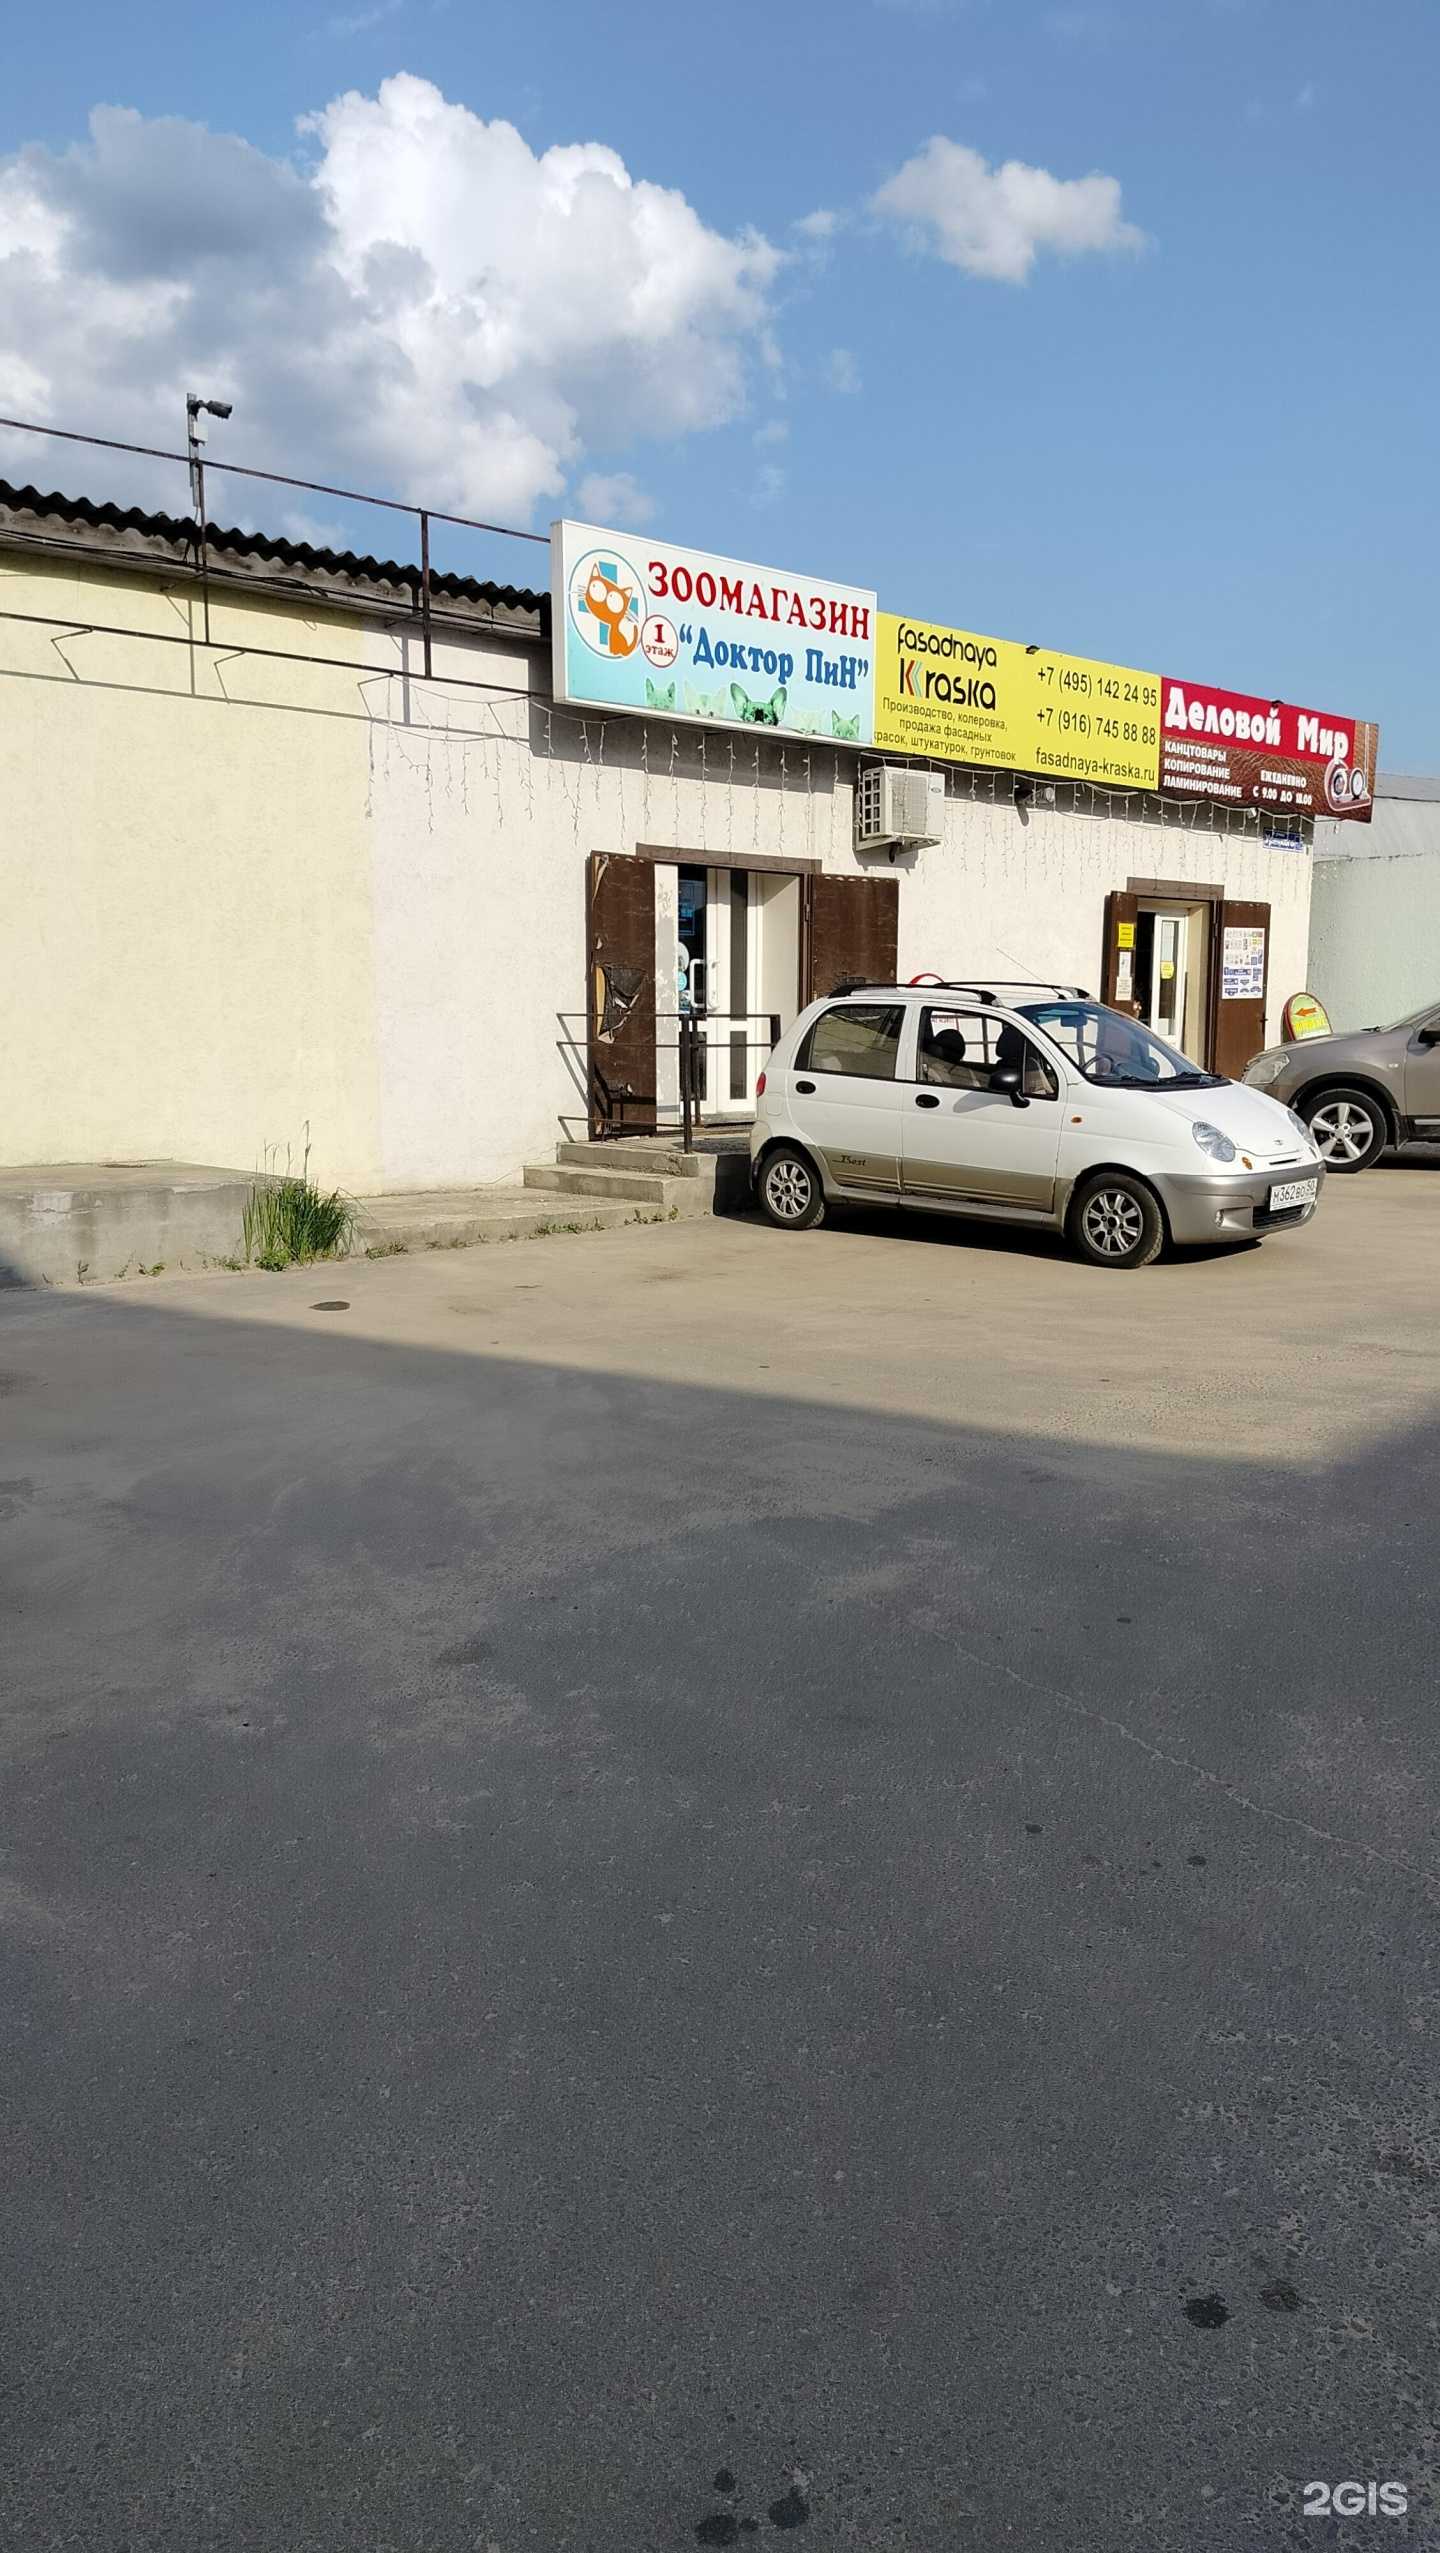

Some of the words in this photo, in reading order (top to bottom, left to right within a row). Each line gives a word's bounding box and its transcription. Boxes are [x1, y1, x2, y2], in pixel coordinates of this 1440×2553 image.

[648, 561, 870, 640] ЗООМАГАЗИН
[654, 624, 666, 643] 1
[645, 644, 675, 658] этаж
[897, 623, 997, 671] fasadnaya
[1037, 666, 1055, 686] +7
[1059, 669, 1092, 699] (495)
[1097, 677, 1120, 699] 142
[1123, 683, 1139, 703] 24
[1142, 687, 1157, 707] 95
[882, 696, 956, 721] Производство,
[957, 713, 1008, 732] колеровка,
[1036, 707, 1054, 727] +7
[1058, 709, 1092, 739] (916)
[1096, 717, 1119, 739] 745
[1123, 722, 1138, 742] 88
[1141, 726, 1156, 745] 88
[1164, 686, 1281, 746] Деловой
[1297, 714, 1349, 765] Мир
[899, 719, 942, 734] продажа
[943, 724, 993, 743] фасадных
[911, 736, 968, 755] штукатурок,
[970, 745, 1017, 761] грунтовок
[1164, 740, 1227, 762] КАНЦТОВАРЫ
[1036, 747, 1155, 781] fasadnaya-kraska.ru
[1164, 758, 1231, 779] КОПИРОВАНИЕ
[1163, 775, 1243, 798] ЛАМИНИРОВАНИЕ
[1280, 790, 1293, 803] ДО
